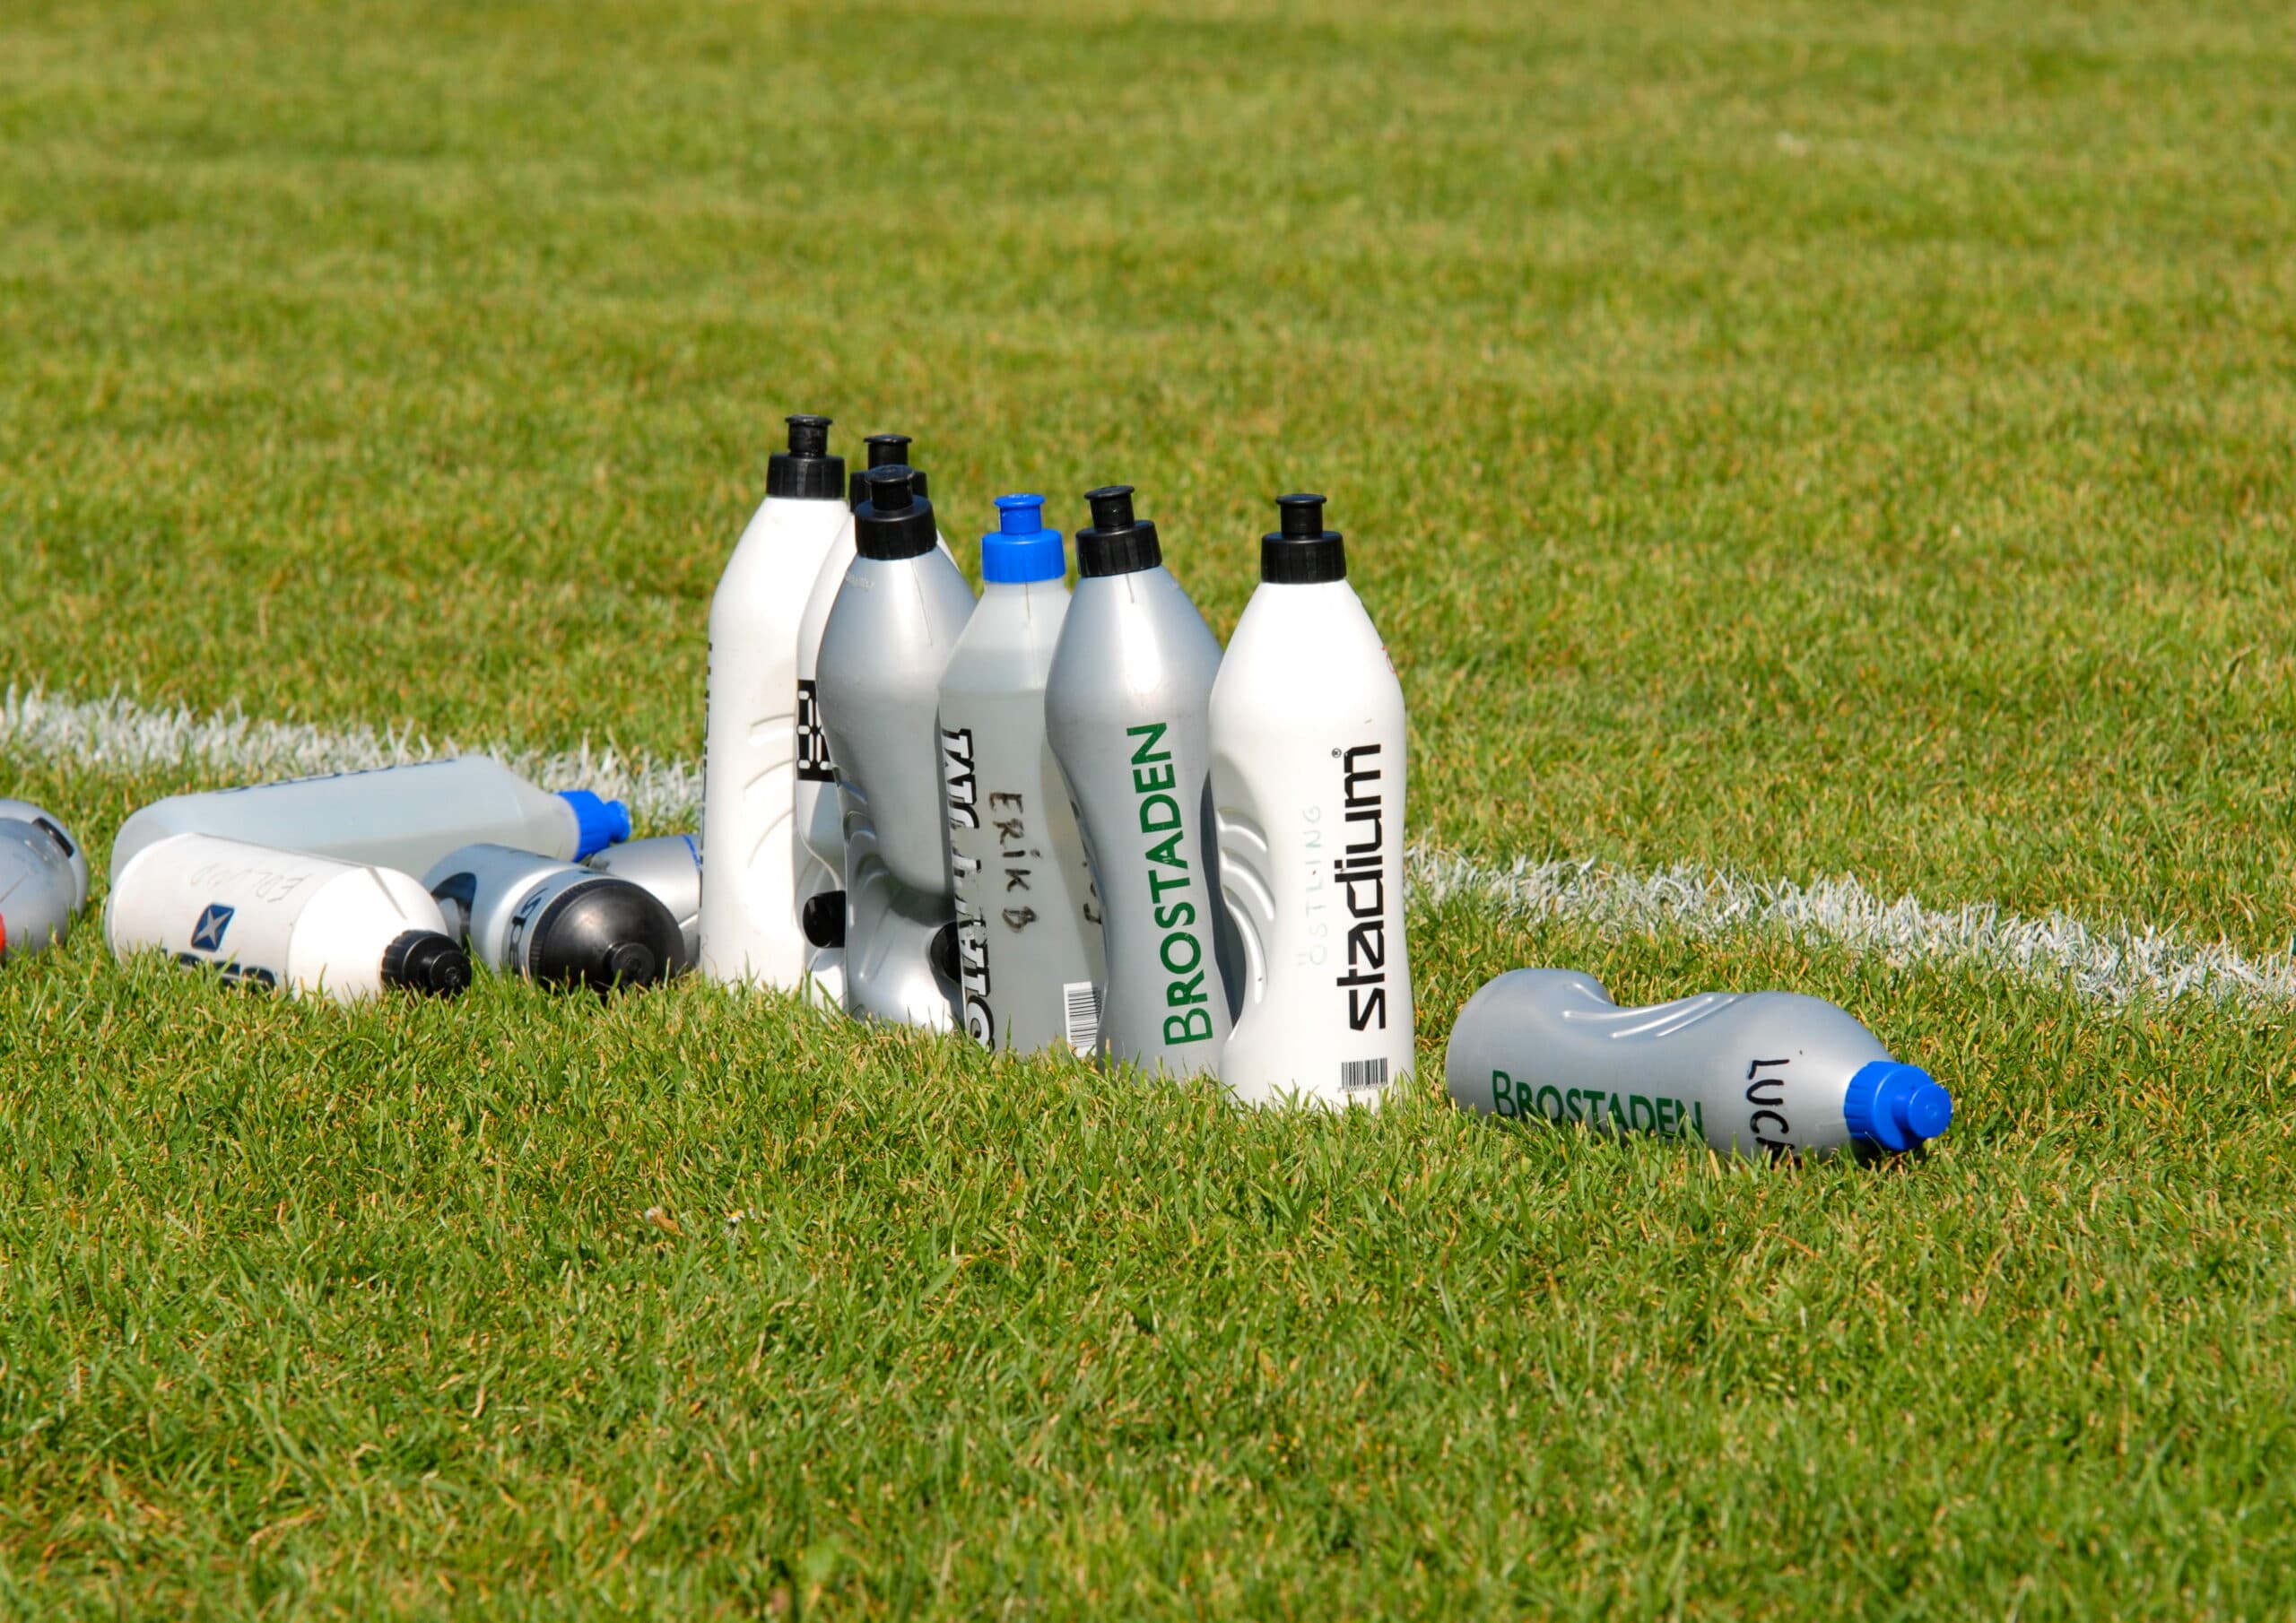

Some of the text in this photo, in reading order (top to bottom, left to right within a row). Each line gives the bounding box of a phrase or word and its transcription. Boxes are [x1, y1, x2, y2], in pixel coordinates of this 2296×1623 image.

[1126, 722, 1213, 1046] BROSTADEN
[1335, 744, 1387, 1032] stadium
[1492, 1069, 1704, 1141] BROSTADEN
